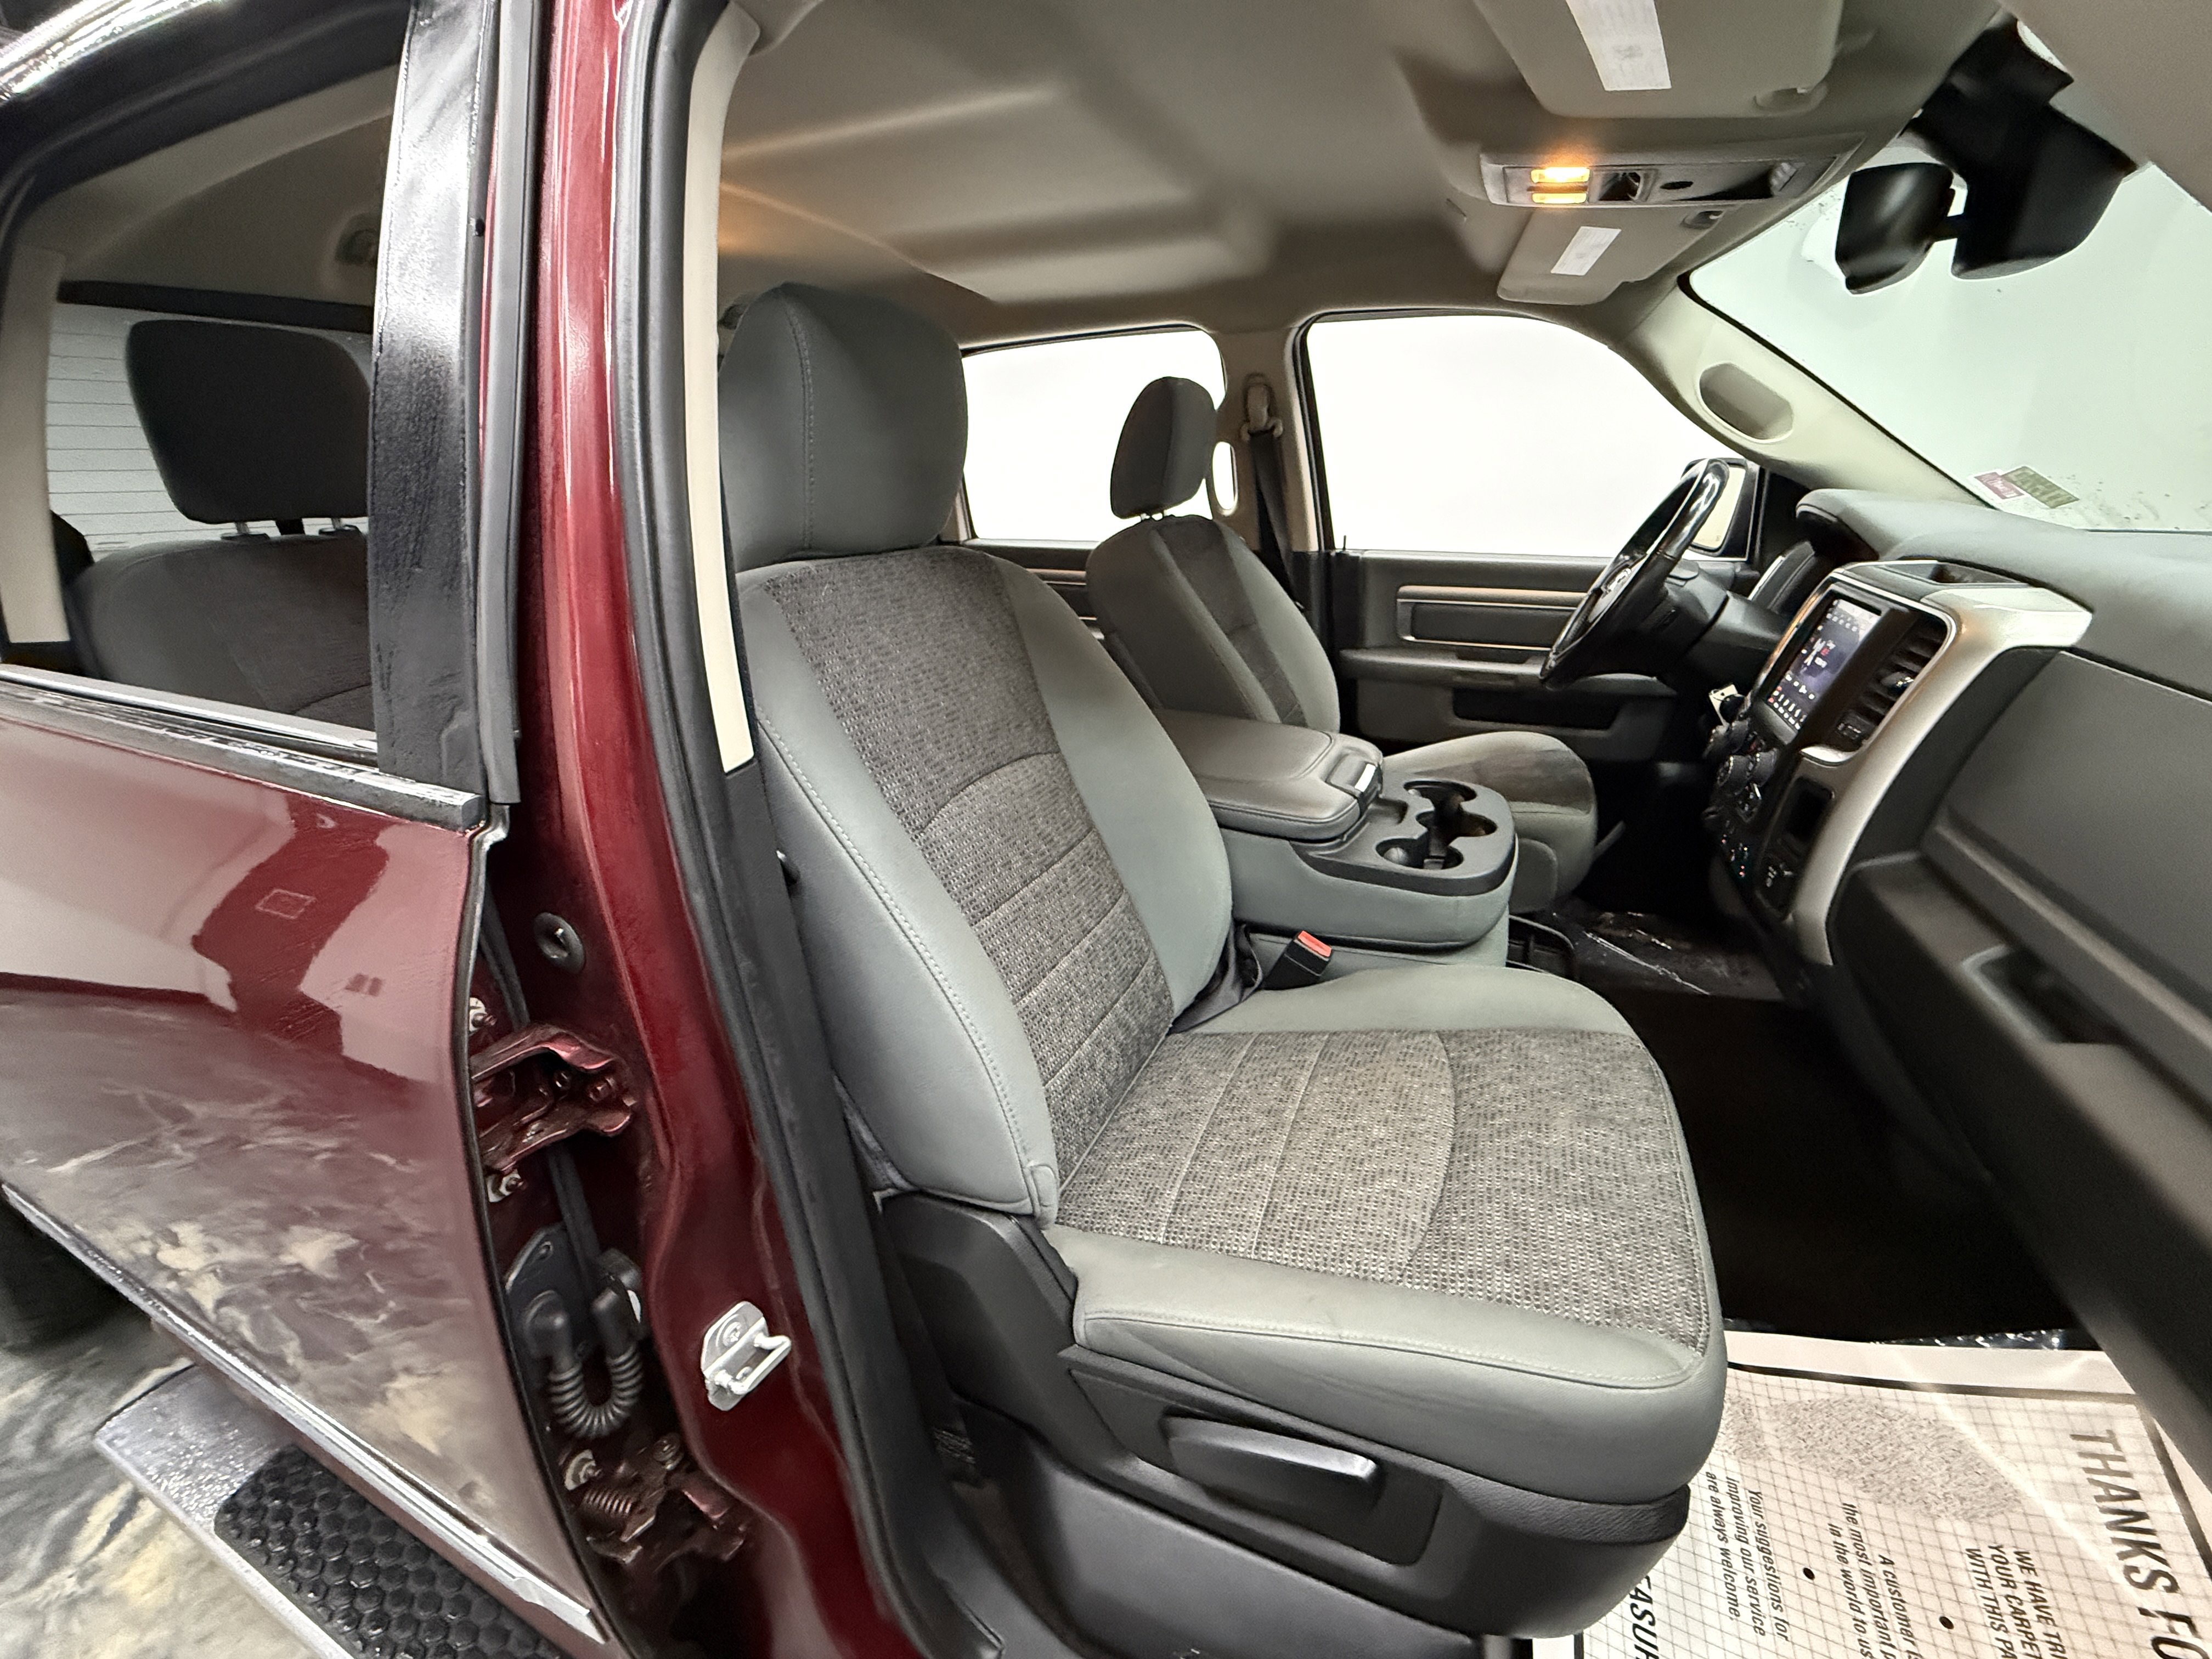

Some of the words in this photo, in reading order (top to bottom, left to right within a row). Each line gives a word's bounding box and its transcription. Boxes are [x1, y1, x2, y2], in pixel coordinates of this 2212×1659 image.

[1706, 1472, 1718, 1493] are
[1710, 1496, 1728, 1544] always
[1726, 1477, 1750, 1545] improving
[1748, 1489, 1765, 1520] Your
[1842, 1503, 1858, 1525] the
[2069, 1429, 2181, 1593] THANKS
[1828, 1523, 1843, 1537] in
[1850, 1528, 1872, 1566] most
[1740, 1548, 1755, 1574] our
[1755, 1521, 1784, 1612] suggestions
[1833, 1541, 1849, 1564] the
[1878, 1555, 1894, 1566] A
[1988, 1545, 2017, 1589] YOUR
[2013, 1551, 2038, 1577] WE
[1745, 1576, 1767, 1637] service
[1840, 1569, 1865, 1615] world
[1860, 1568, 1896, 1649] important
[1883, 1570, 1918, 1646] customer
[1966, 1548, 1993, 1590] WITH
[1980, 1594, 2010, 1633] THIS
[2024, 1581, 2057, 1627] HAVE
[1775, 1617, 1789, 1641] for
[1852, 1618, 1867, 1634] to
